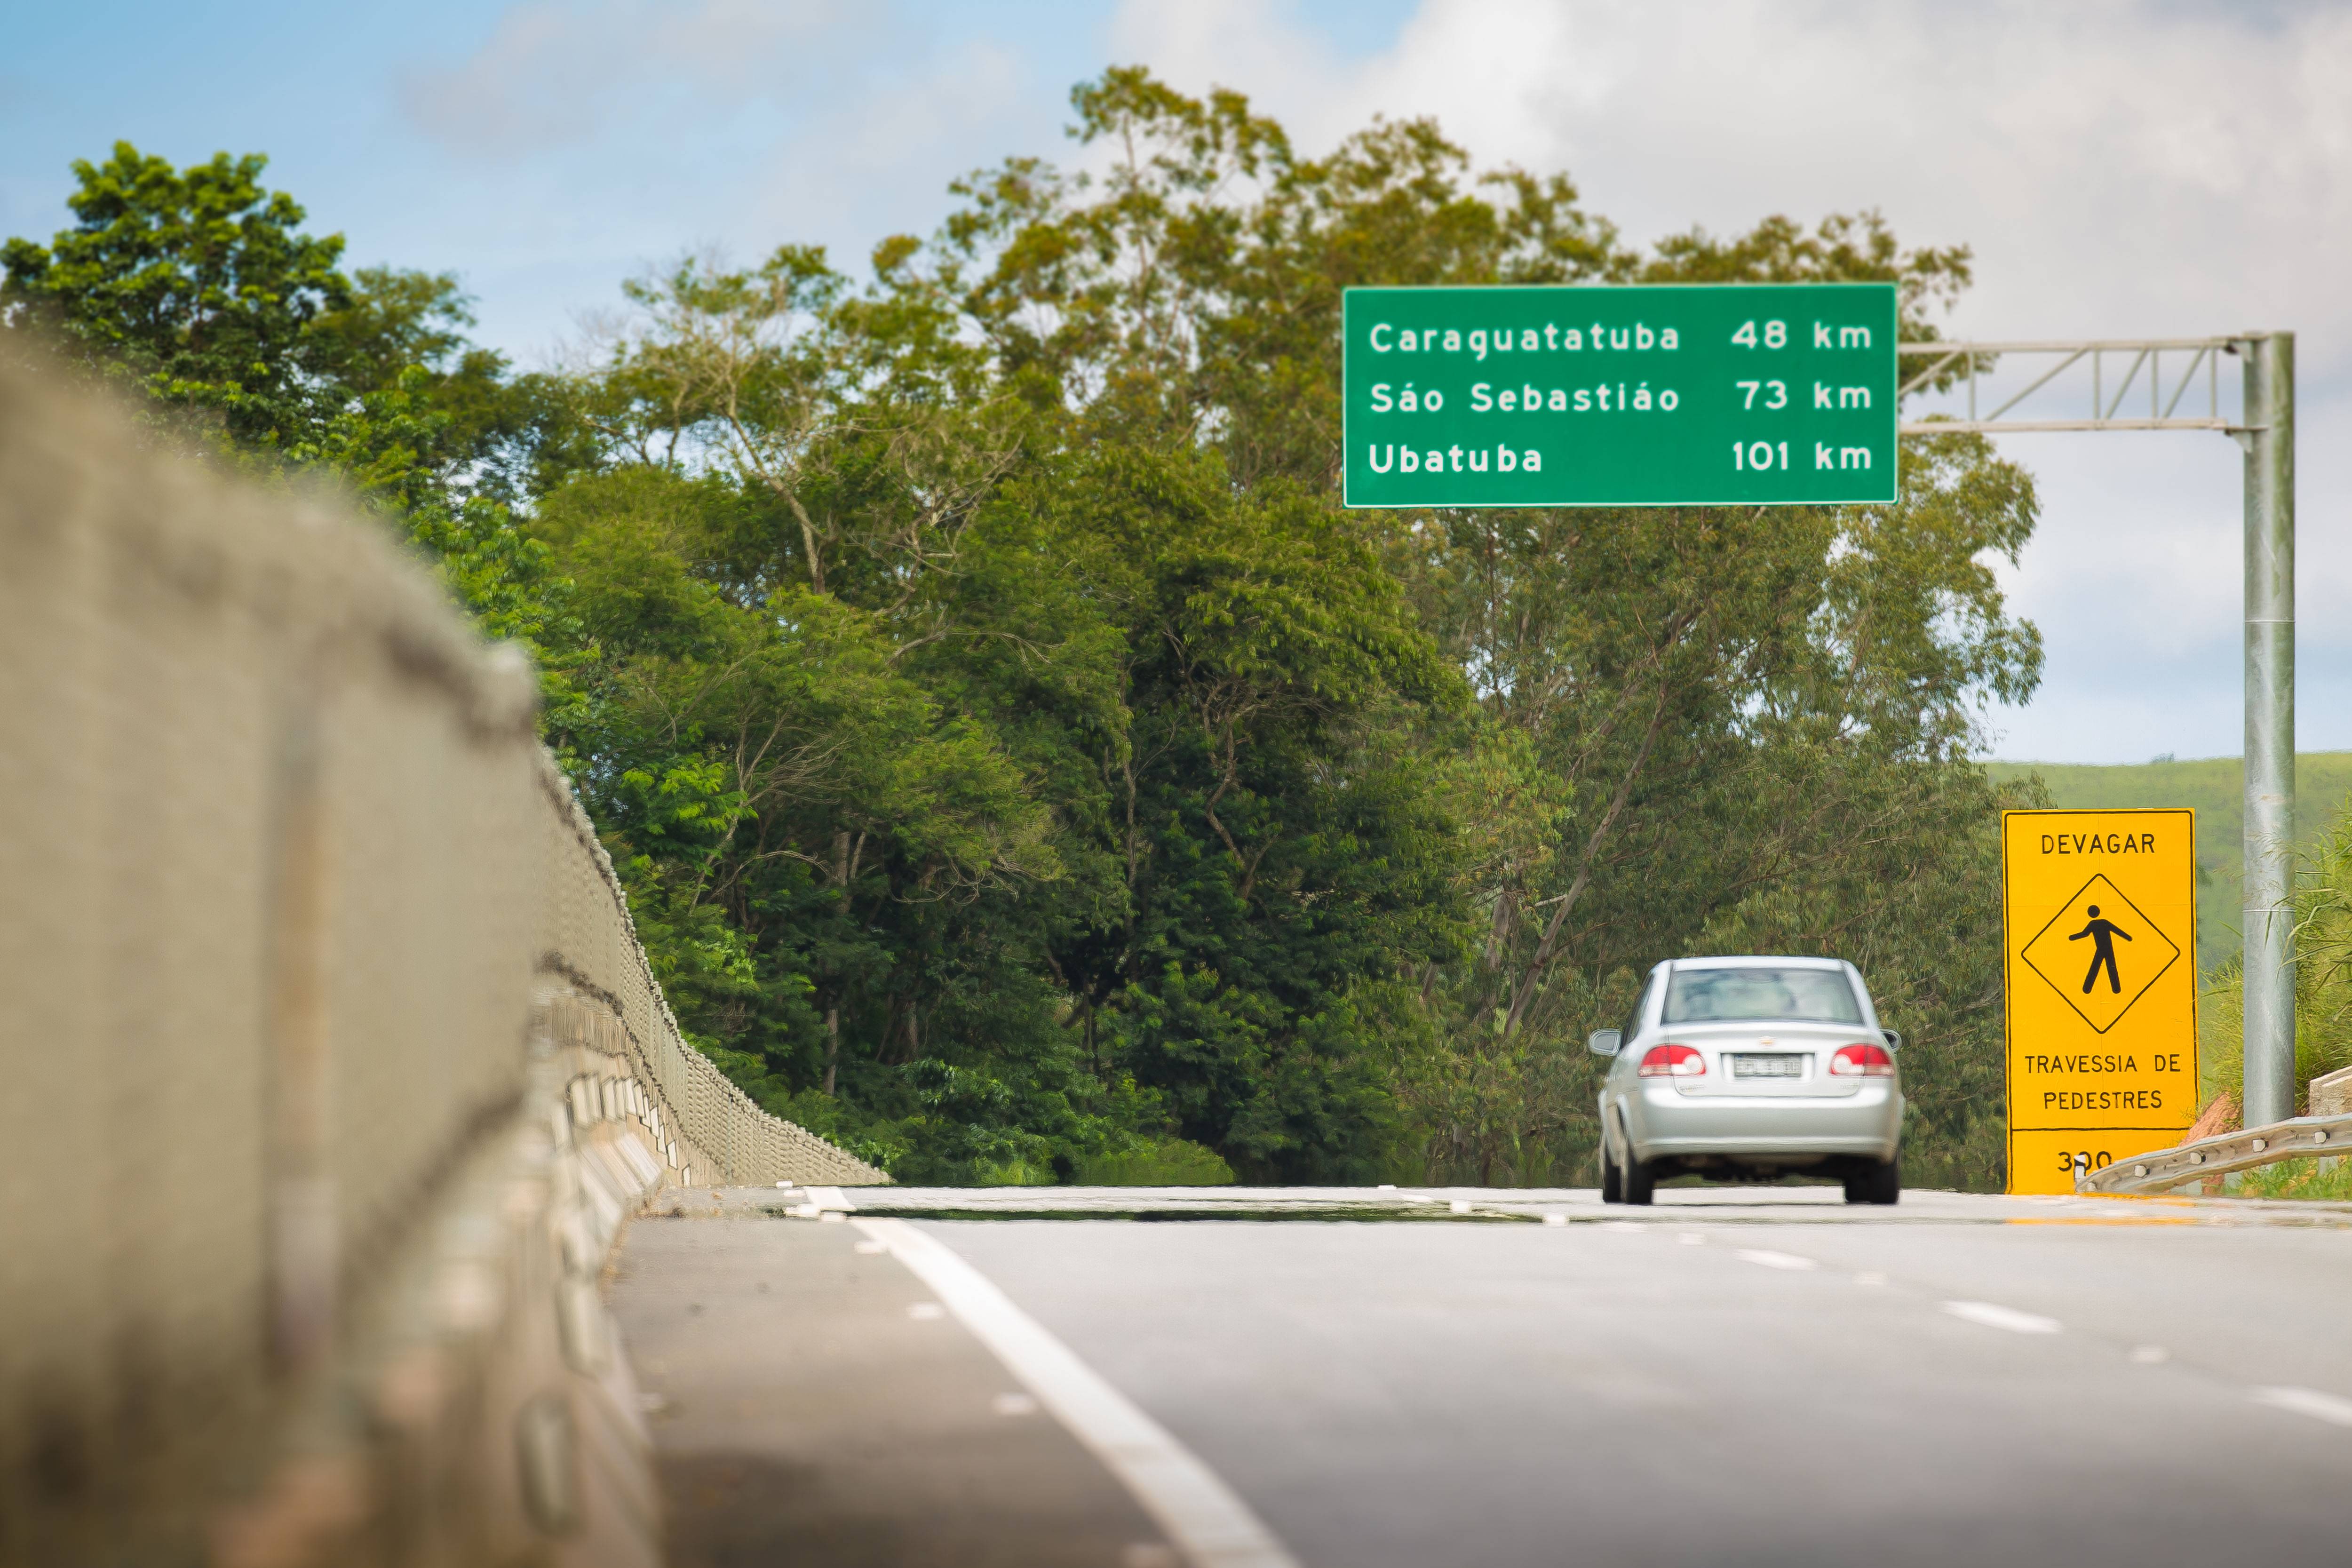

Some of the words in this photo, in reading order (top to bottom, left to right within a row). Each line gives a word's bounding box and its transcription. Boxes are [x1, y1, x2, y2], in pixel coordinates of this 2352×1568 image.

[1370, 322, 1678, 361] Caraguatatuba
[1731, 320, 1787, 349] 48
[1814, 321, 1871, 349] km
[1736, 380, 1788, 410] 73
[1814, 382, 1871, 409] km
[1369, 443, 1542, 474] Ubatuba
[1733, 441, 1788, 471] 101
[1815, 441, 1871, 470] km
[2042, 833, 2155, 855] DEVAGAR
[2025, 1054, 2137, 1074] TRAVESSIA
[2154, 1053, 2181, 1073] DE
[2043, 1090, 2162, 1110] PEDESTRES
